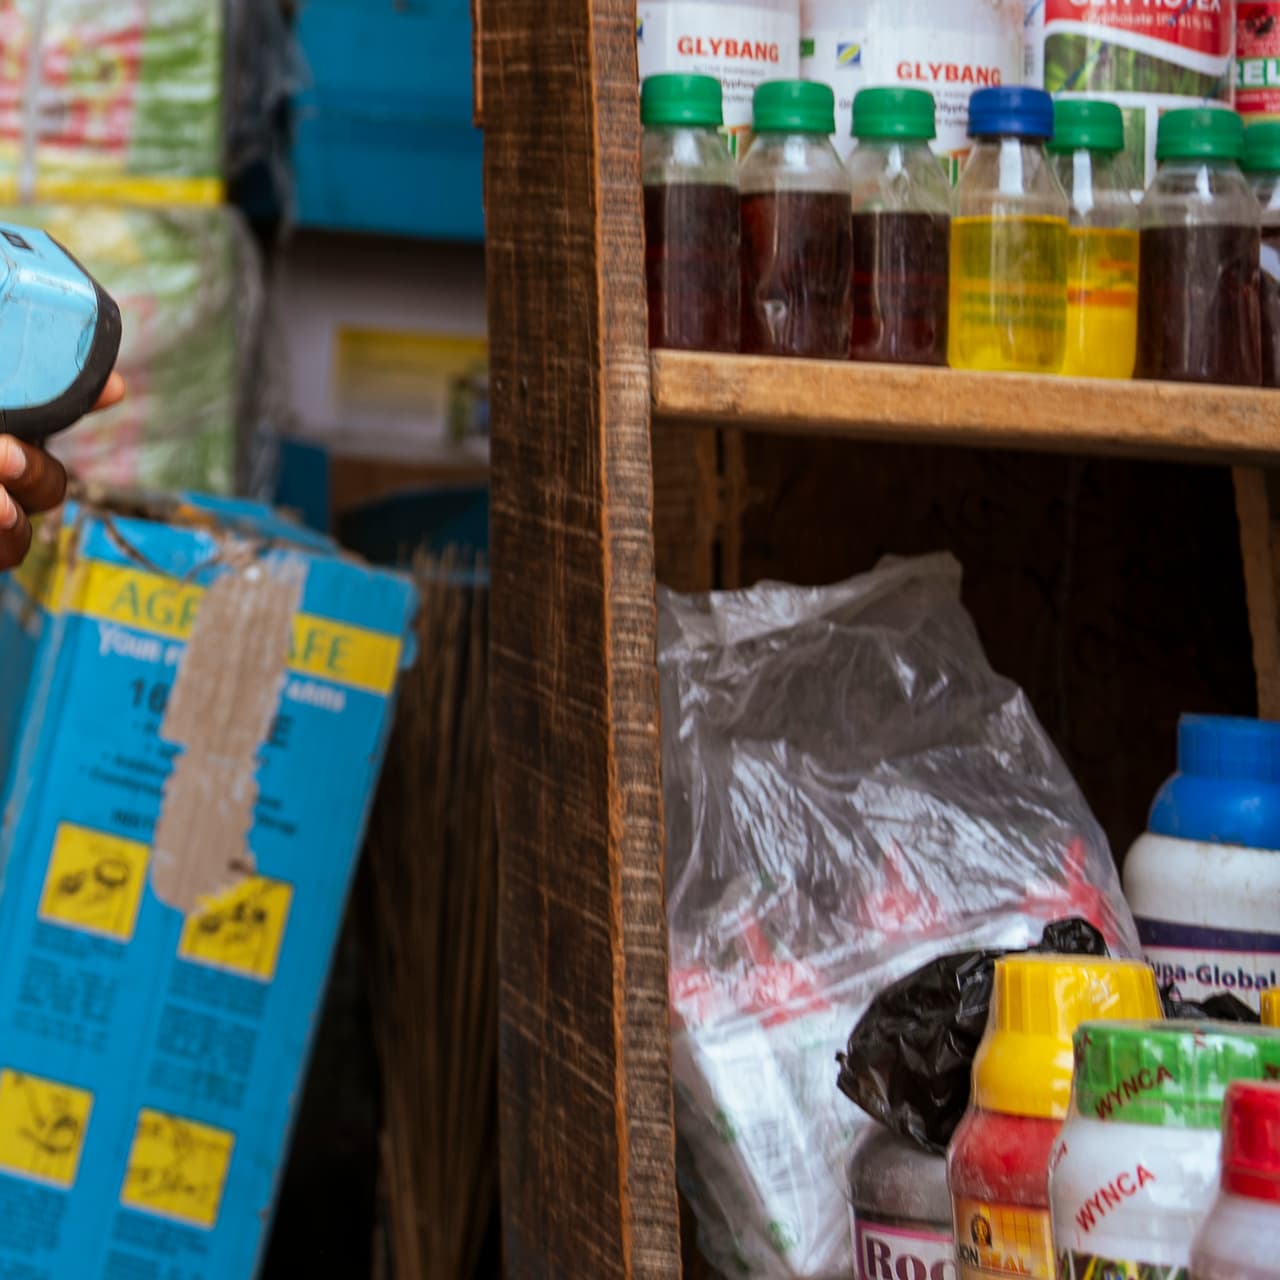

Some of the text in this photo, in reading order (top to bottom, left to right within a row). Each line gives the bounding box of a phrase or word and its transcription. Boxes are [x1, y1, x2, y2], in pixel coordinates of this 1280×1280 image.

[677, 37, 780, 63] GLYBANG
[896, 61, 1002, 87] GLYBANG
[1095, 1062, 1175, 1120] WYNCA
[1075, 1164, 1157, 1234] WYNCA
